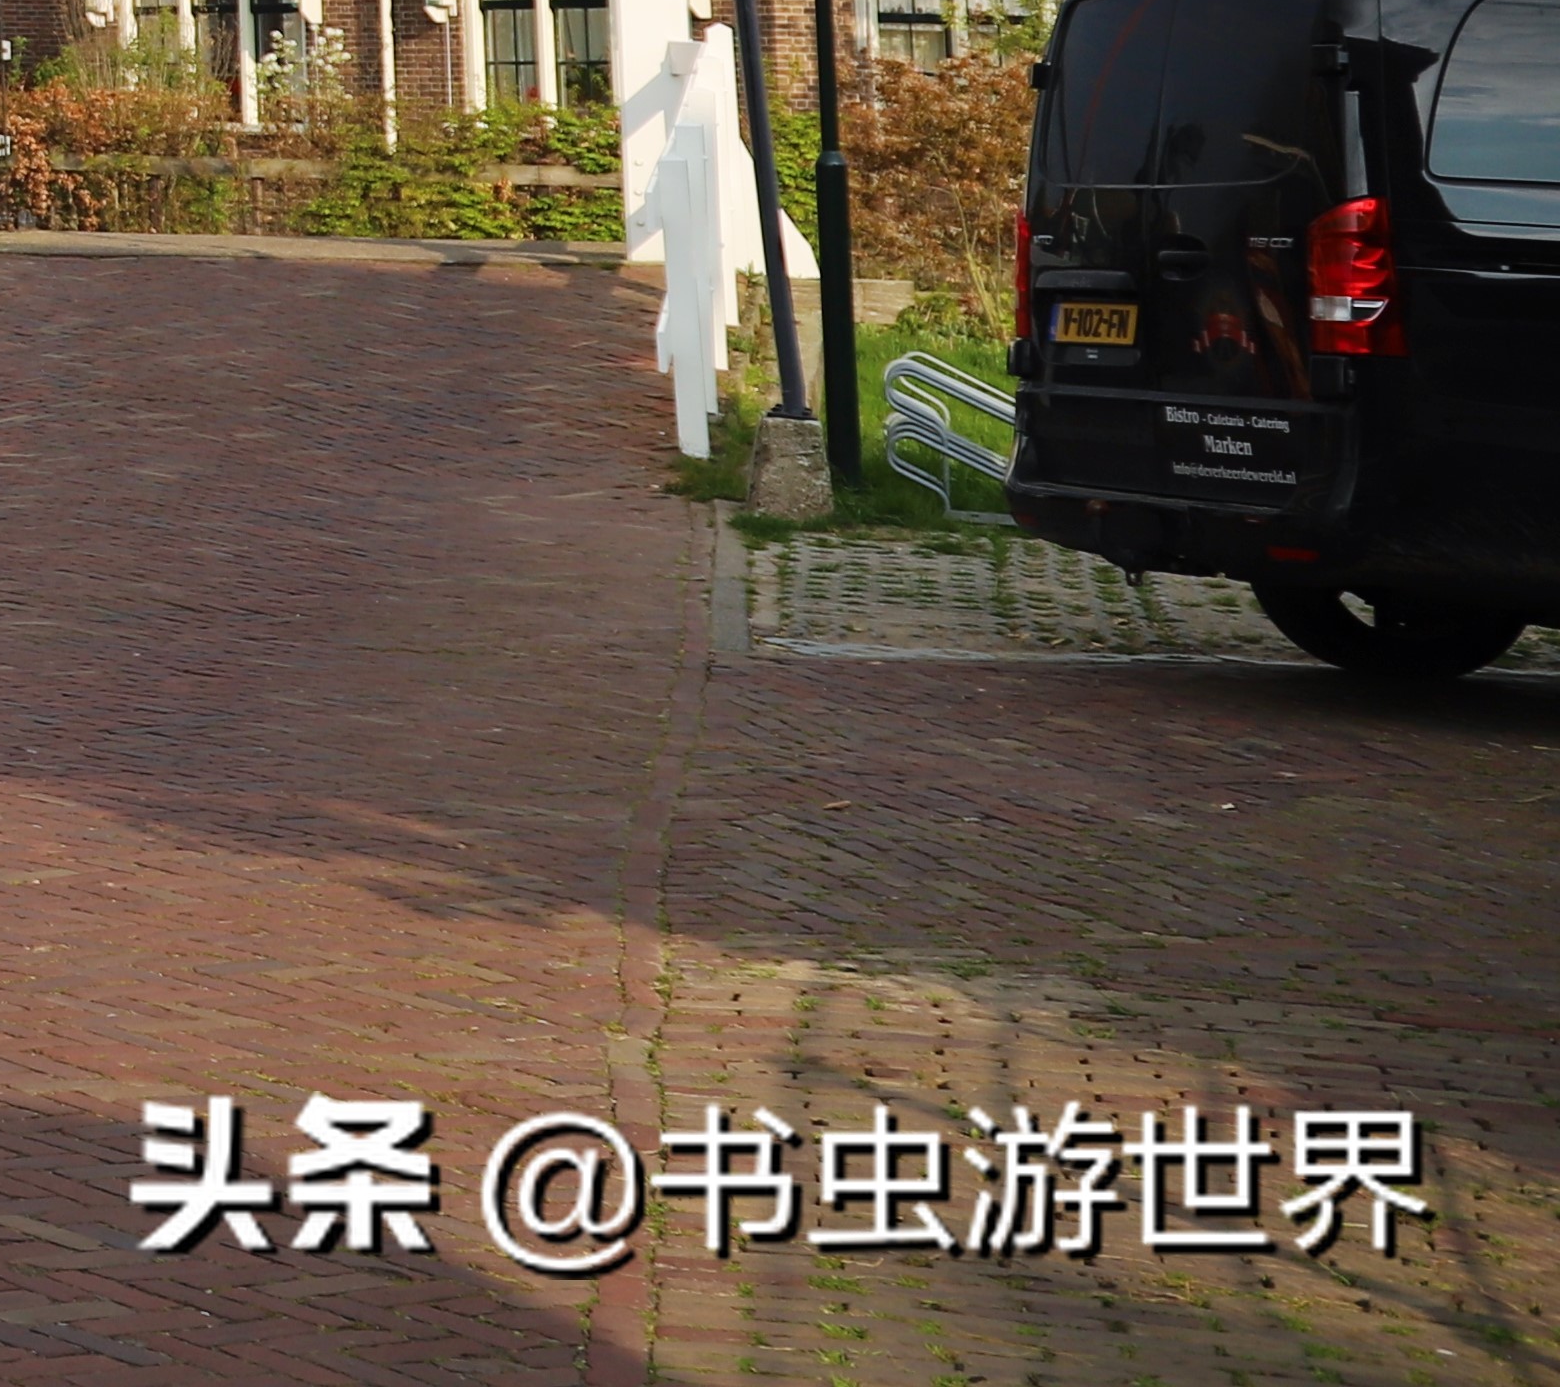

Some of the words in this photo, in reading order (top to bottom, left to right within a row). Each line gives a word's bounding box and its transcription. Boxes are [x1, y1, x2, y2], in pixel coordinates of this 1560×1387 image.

[1063, 307, 1131, 339] V-102-FN
[1165, 406, 1200, 424] Bistro
[1207, 413, 1244, 427] Cafetaria
[1251, 416, 1290, 434] Catering
[1203, 434, 1253, 456] Marken
